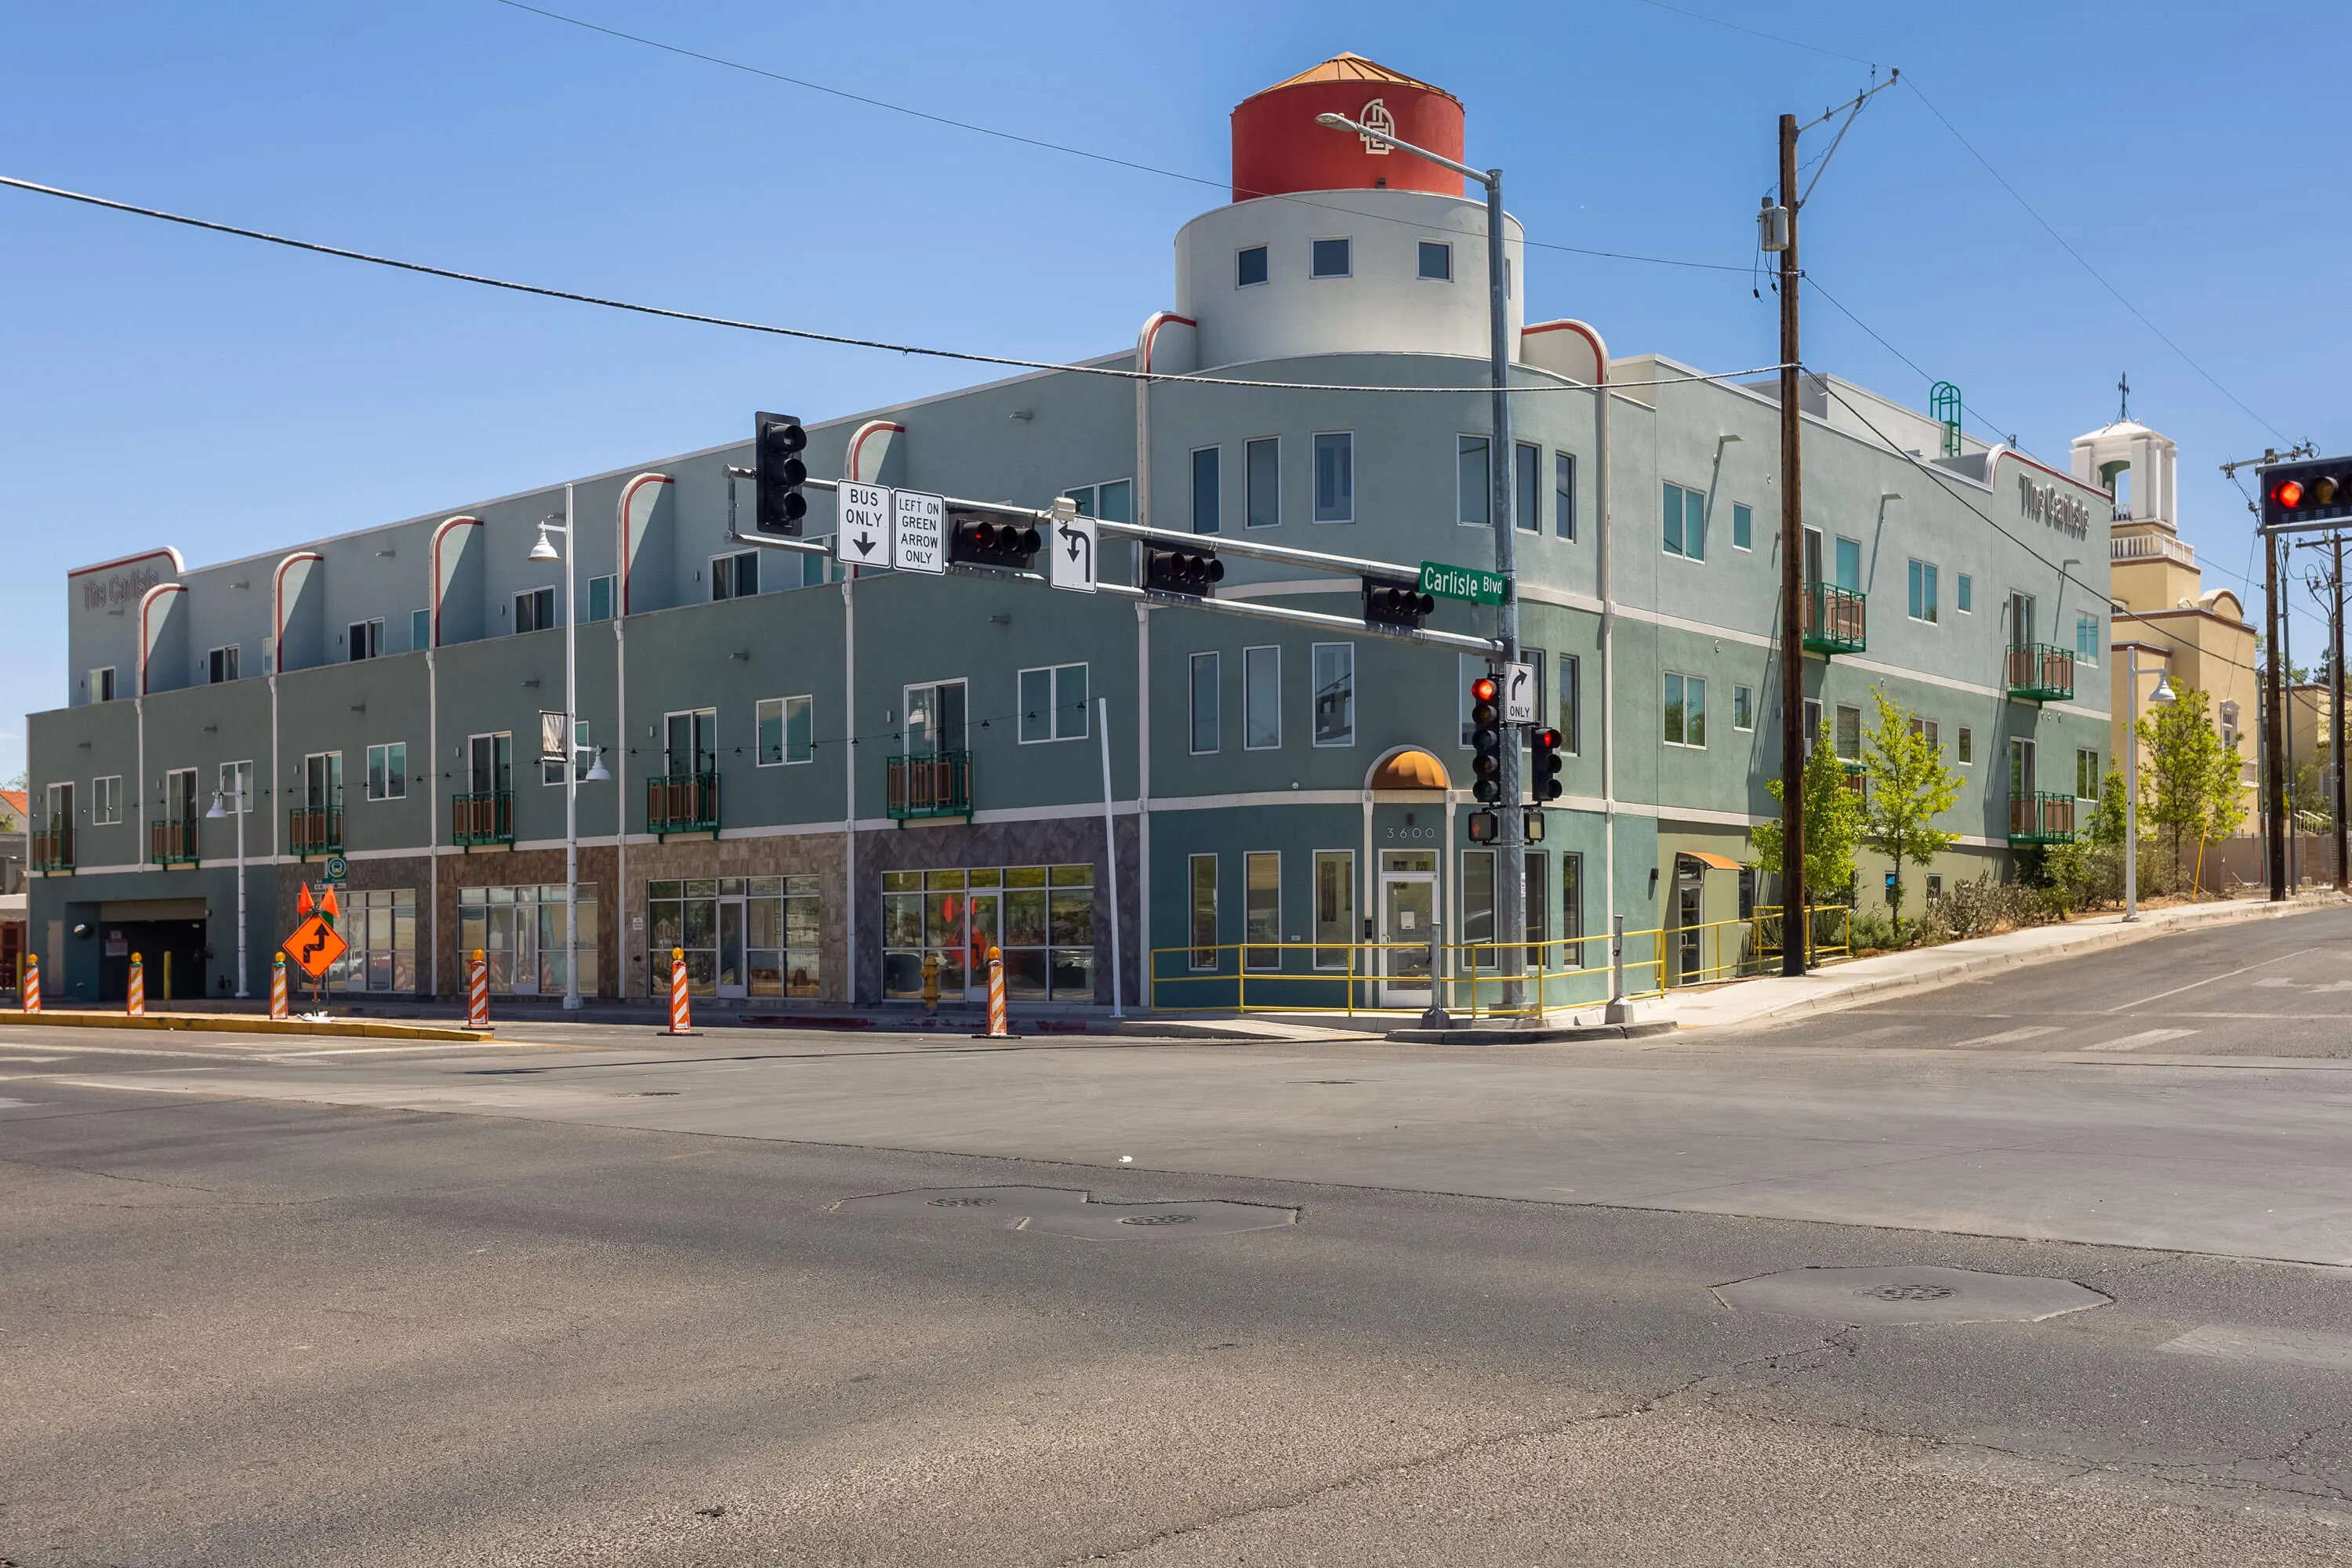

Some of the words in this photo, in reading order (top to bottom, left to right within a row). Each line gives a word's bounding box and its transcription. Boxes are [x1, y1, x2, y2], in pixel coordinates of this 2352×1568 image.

[850, 488, 878, 506] BUS
[2019, 471, 2044, 518] The
[2045, 483, 2089, 537] Carlisle
[899, 498, 922, 513] LEFT
[927, 503, 939, 516] ON
[846, 509, 883, 528] ONLY
[902, 515, 937, 532] GREEN
[900, 532, 938, 549] ARROW
[906, 550, 932, 564] ONLY
[1425, 566, 1478, 597] Carlisle
[1483, 575, 1503, 594] Blvd
[82, 579, 107, 610] The
[1509, 706, 1530, 718] ONLY
[1385, 827, 1435, 839] 3600
